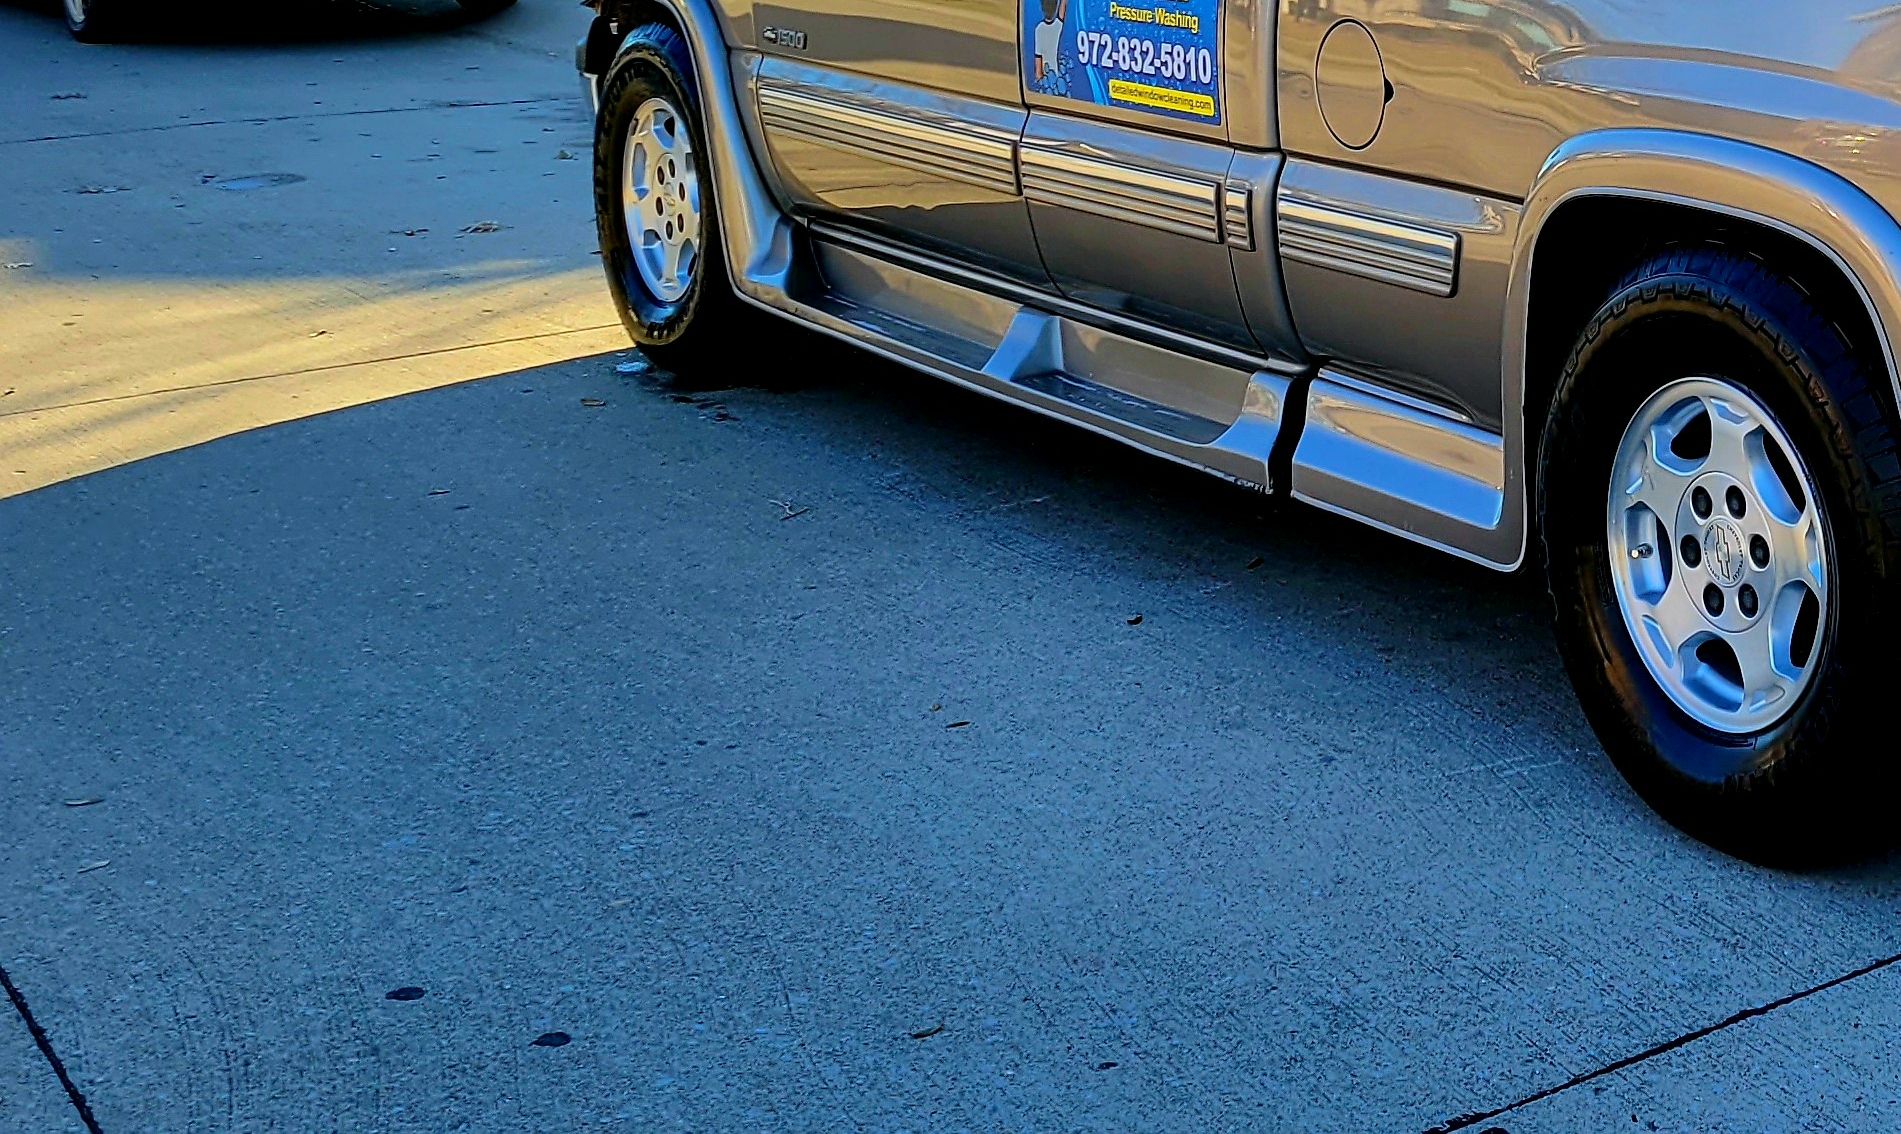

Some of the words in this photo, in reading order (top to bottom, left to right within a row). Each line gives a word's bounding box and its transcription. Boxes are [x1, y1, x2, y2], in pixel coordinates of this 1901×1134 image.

[1109, 2, 1153, 22] Pressure
[1154, 7, 1199, 33] Washing
[1076, 30, 1213, 84] 972-832-5810
[1111, 84, 1212, 112] detailedwindowcleaning.com
